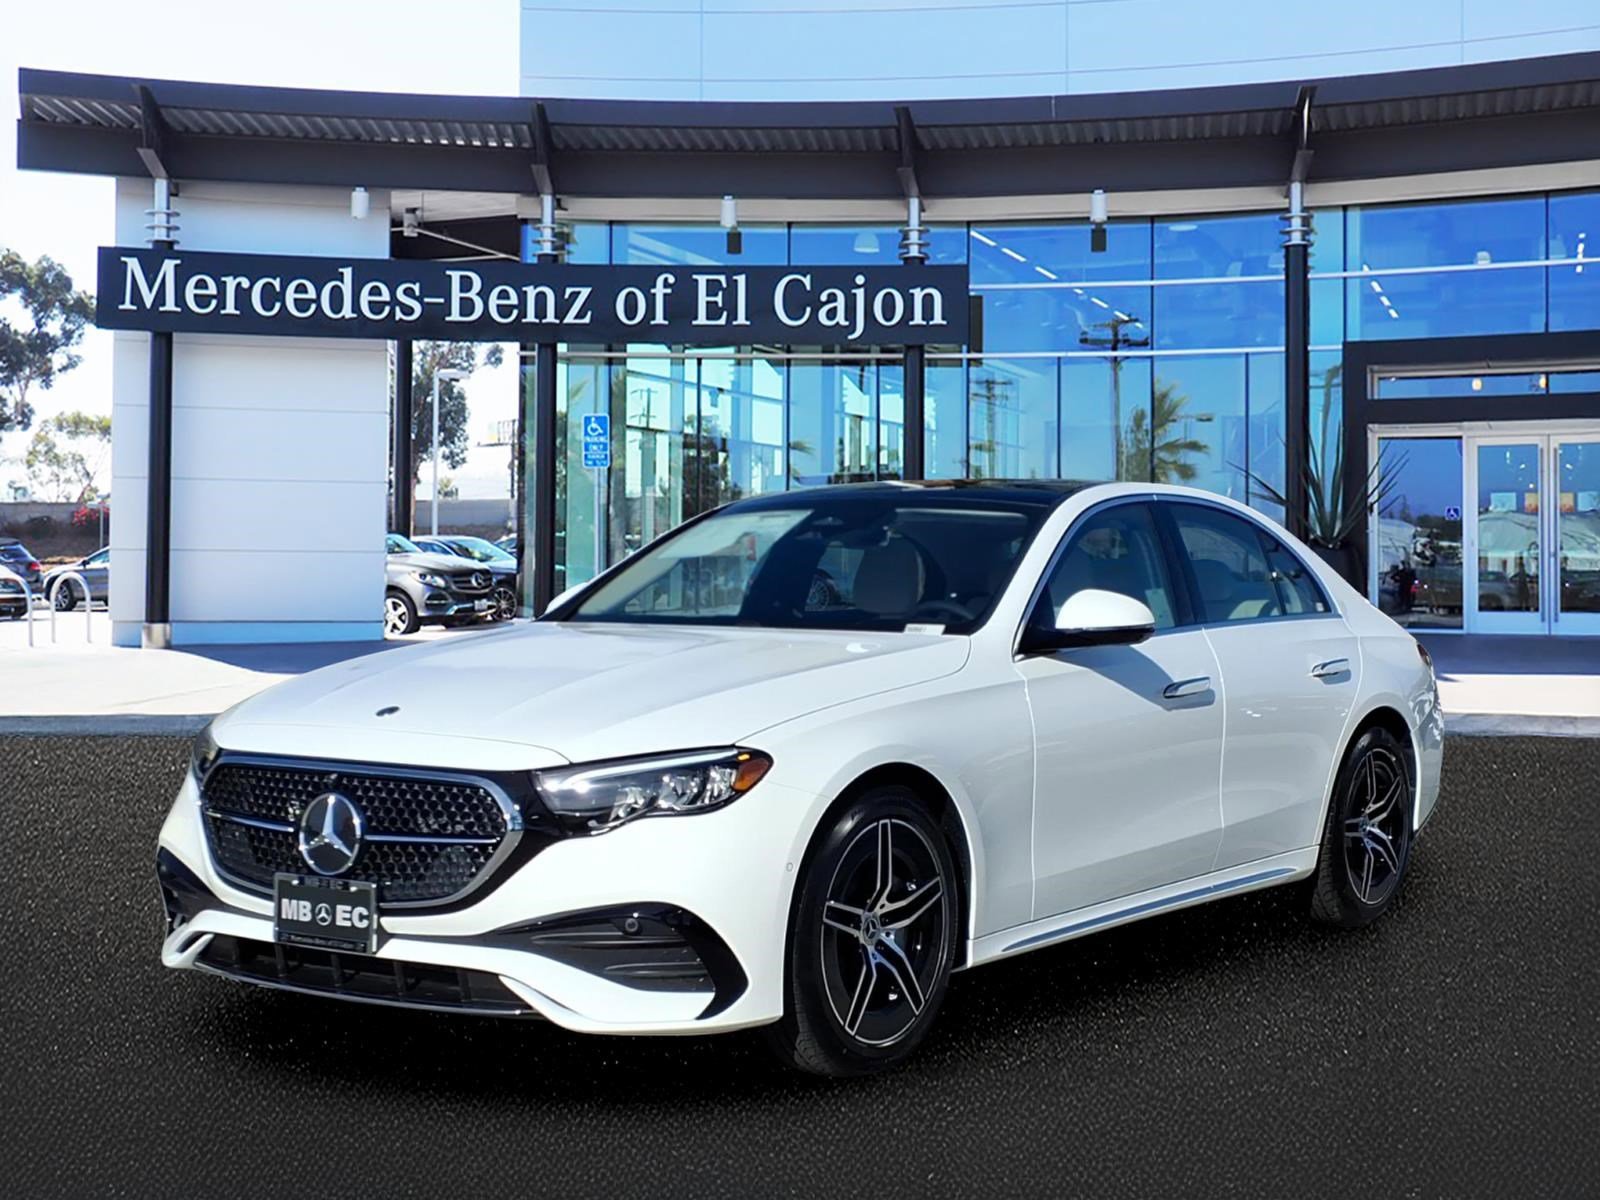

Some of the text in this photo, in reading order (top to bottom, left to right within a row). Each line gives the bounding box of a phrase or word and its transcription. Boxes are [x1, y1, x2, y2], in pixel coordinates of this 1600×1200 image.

[118, 256, 948, 340] Mercedes-Benz of El Cajon
[281, 898, 369, 928] MB EC
